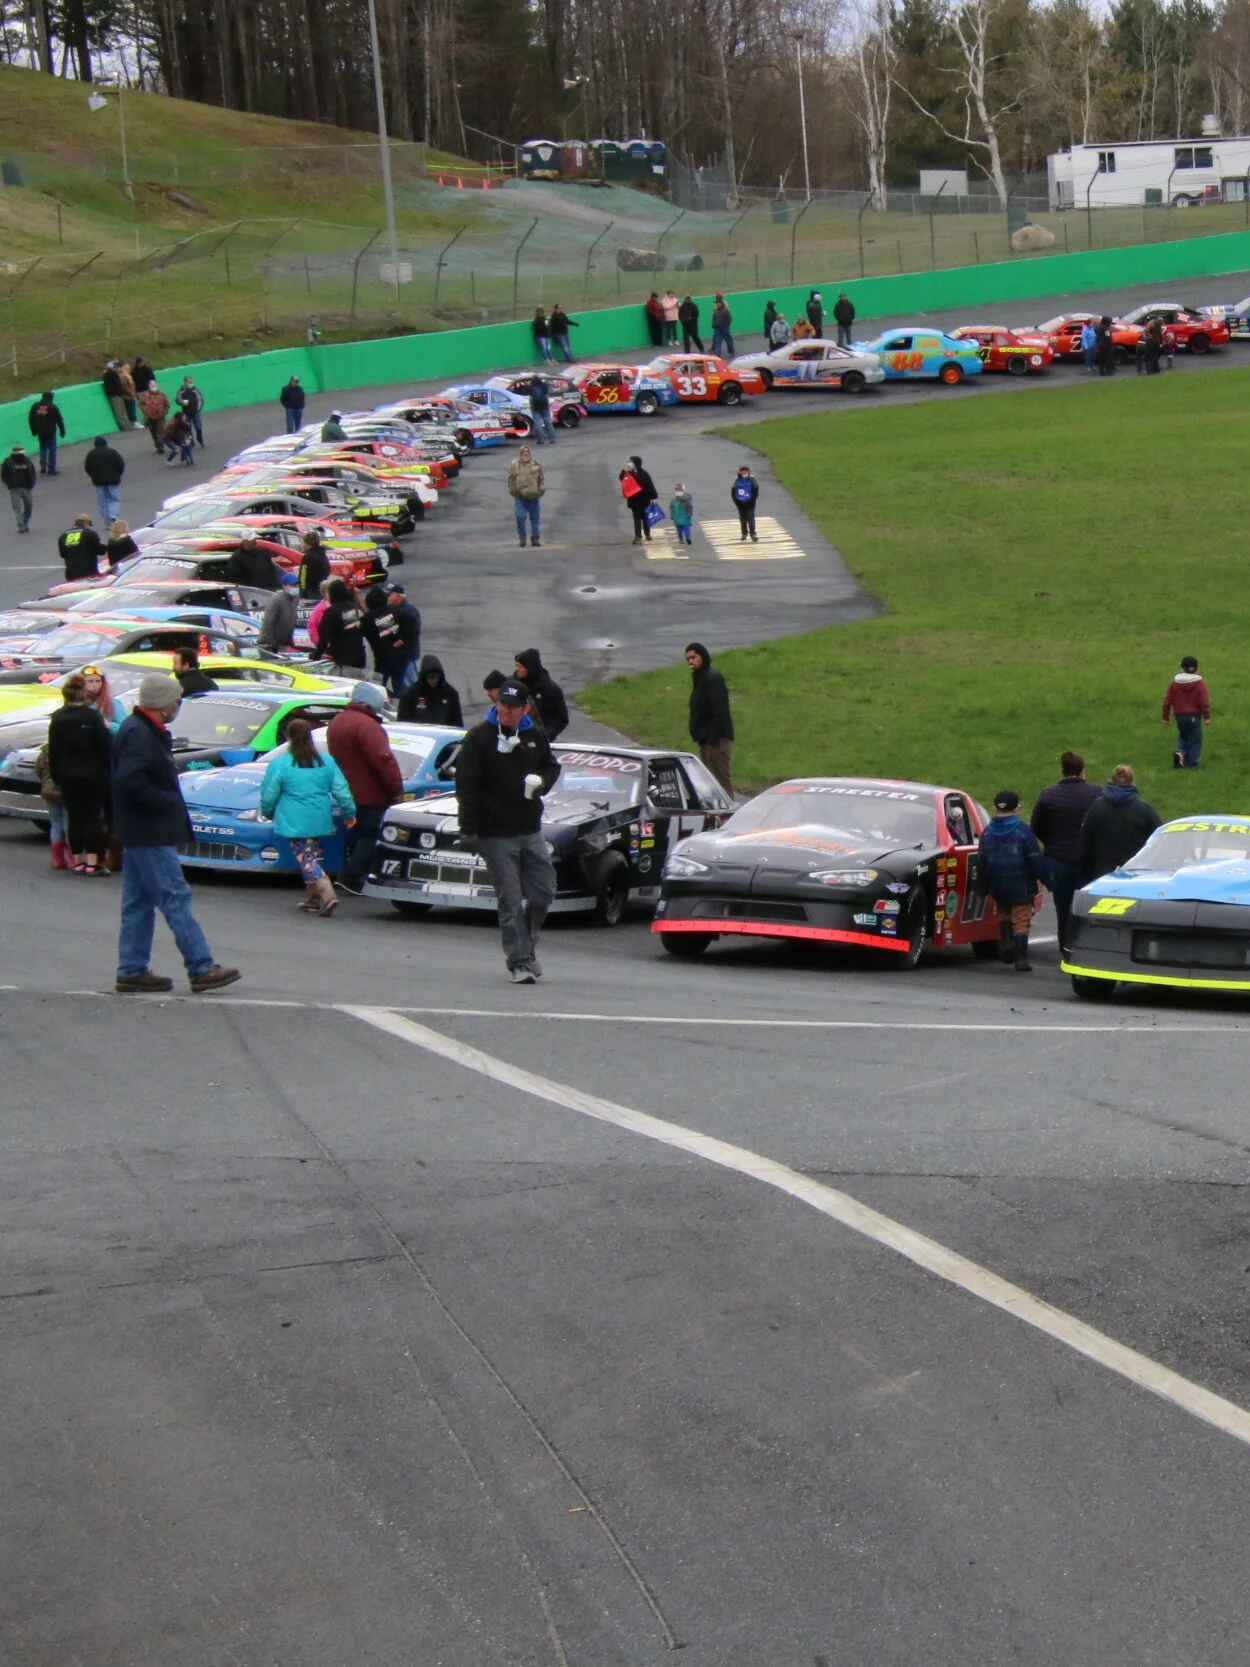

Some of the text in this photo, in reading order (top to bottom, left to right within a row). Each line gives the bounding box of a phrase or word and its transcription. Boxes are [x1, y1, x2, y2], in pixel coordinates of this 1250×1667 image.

[893, 351, 923, 371] 88
[678, 376, 706, 396] 33
[596, 387, 618, 404] 56
[557, 753, 641, 772] CHOPO
[804, 786, 920, 800] STREETER
[382, 860, 400, 874] 17
